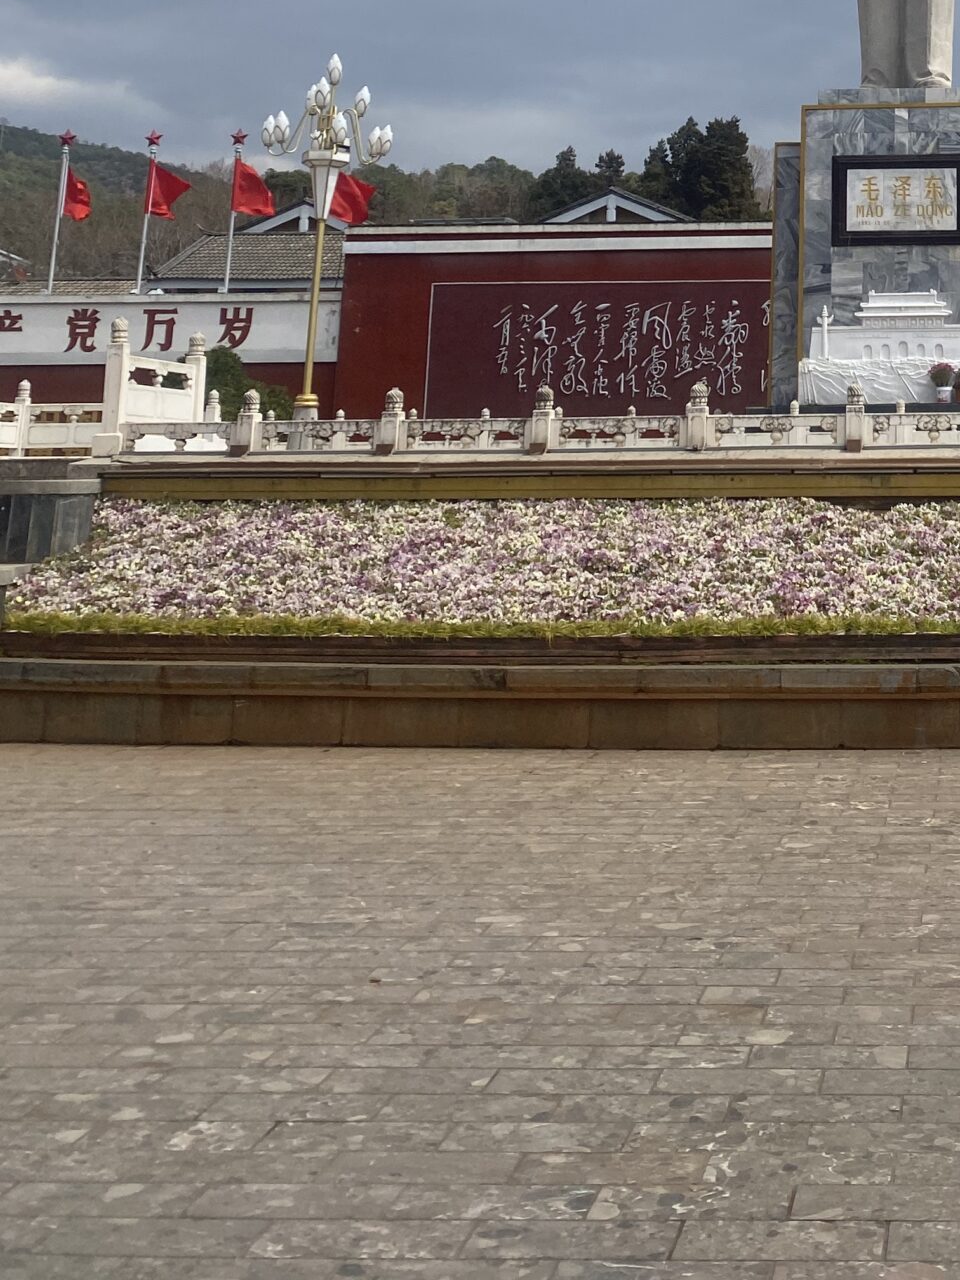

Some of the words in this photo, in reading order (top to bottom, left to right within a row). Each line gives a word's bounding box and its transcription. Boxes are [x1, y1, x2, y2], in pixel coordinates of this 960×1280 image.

[861, 176, 943, 201] 毛泽东
[856, 205, 884, 218] MAO
[893, 205, 911, 217] ZE
[916, 205, 953, 217] DONG
